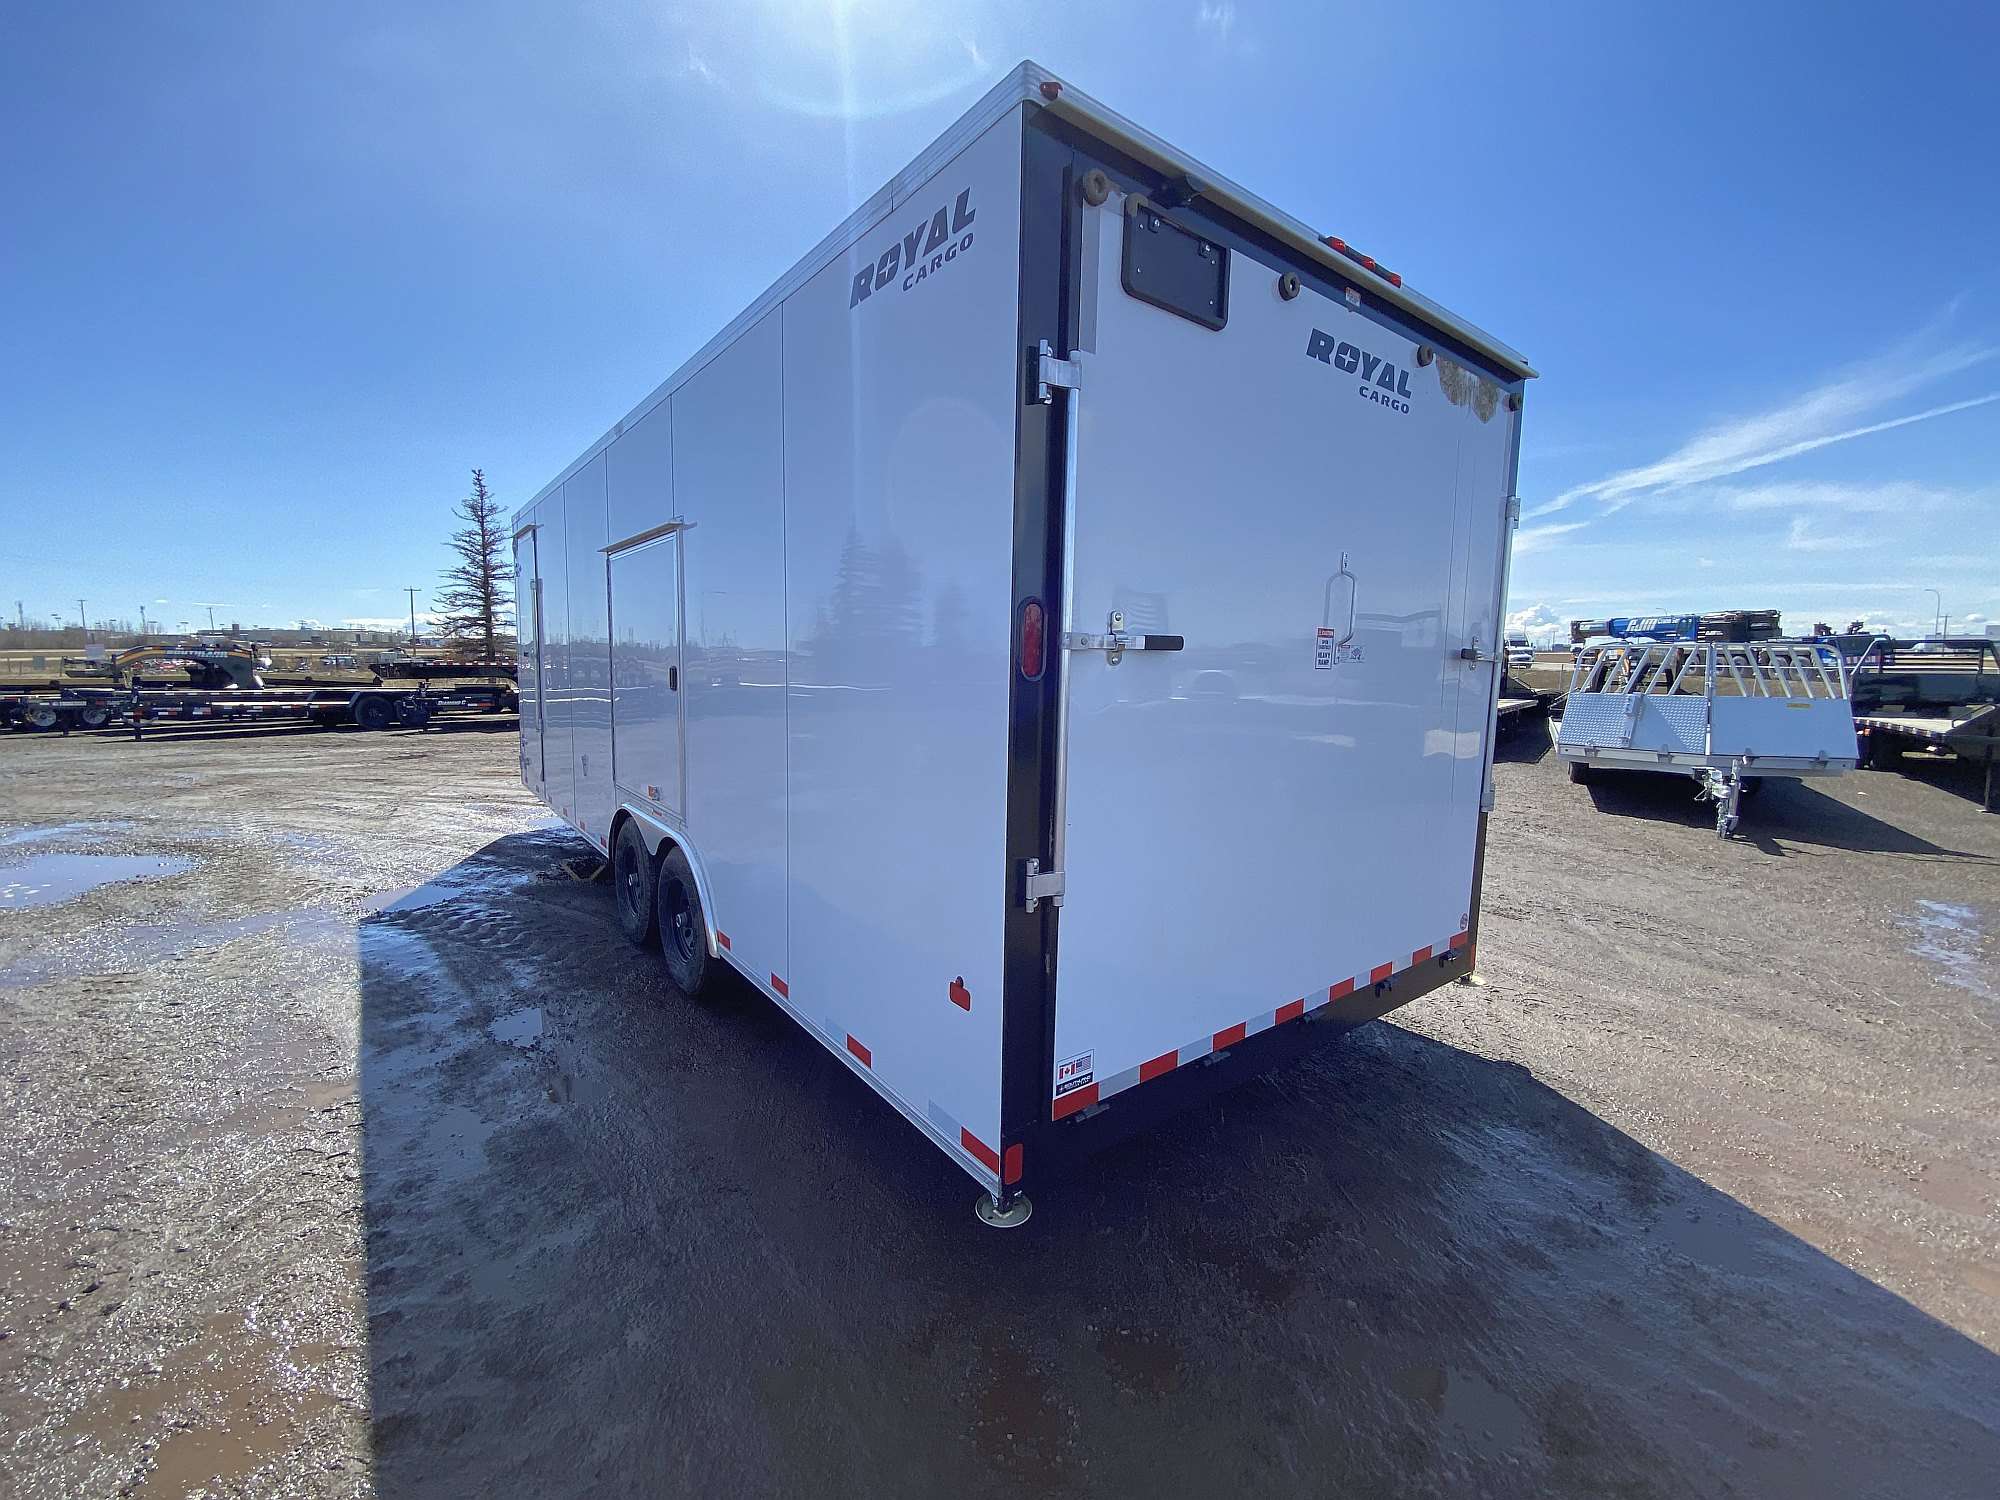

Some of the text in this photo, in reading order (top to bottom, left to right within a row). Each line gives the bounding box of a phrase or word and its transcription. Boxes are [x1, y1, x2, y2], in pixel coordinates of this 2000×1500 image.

[850, 186, 976, 309] ROYAL
[903, 232, 974, 292] CARGO
[1306, 328, 1412, 399] ROYAL
[1359, 385, 1410, 414] CARGO
